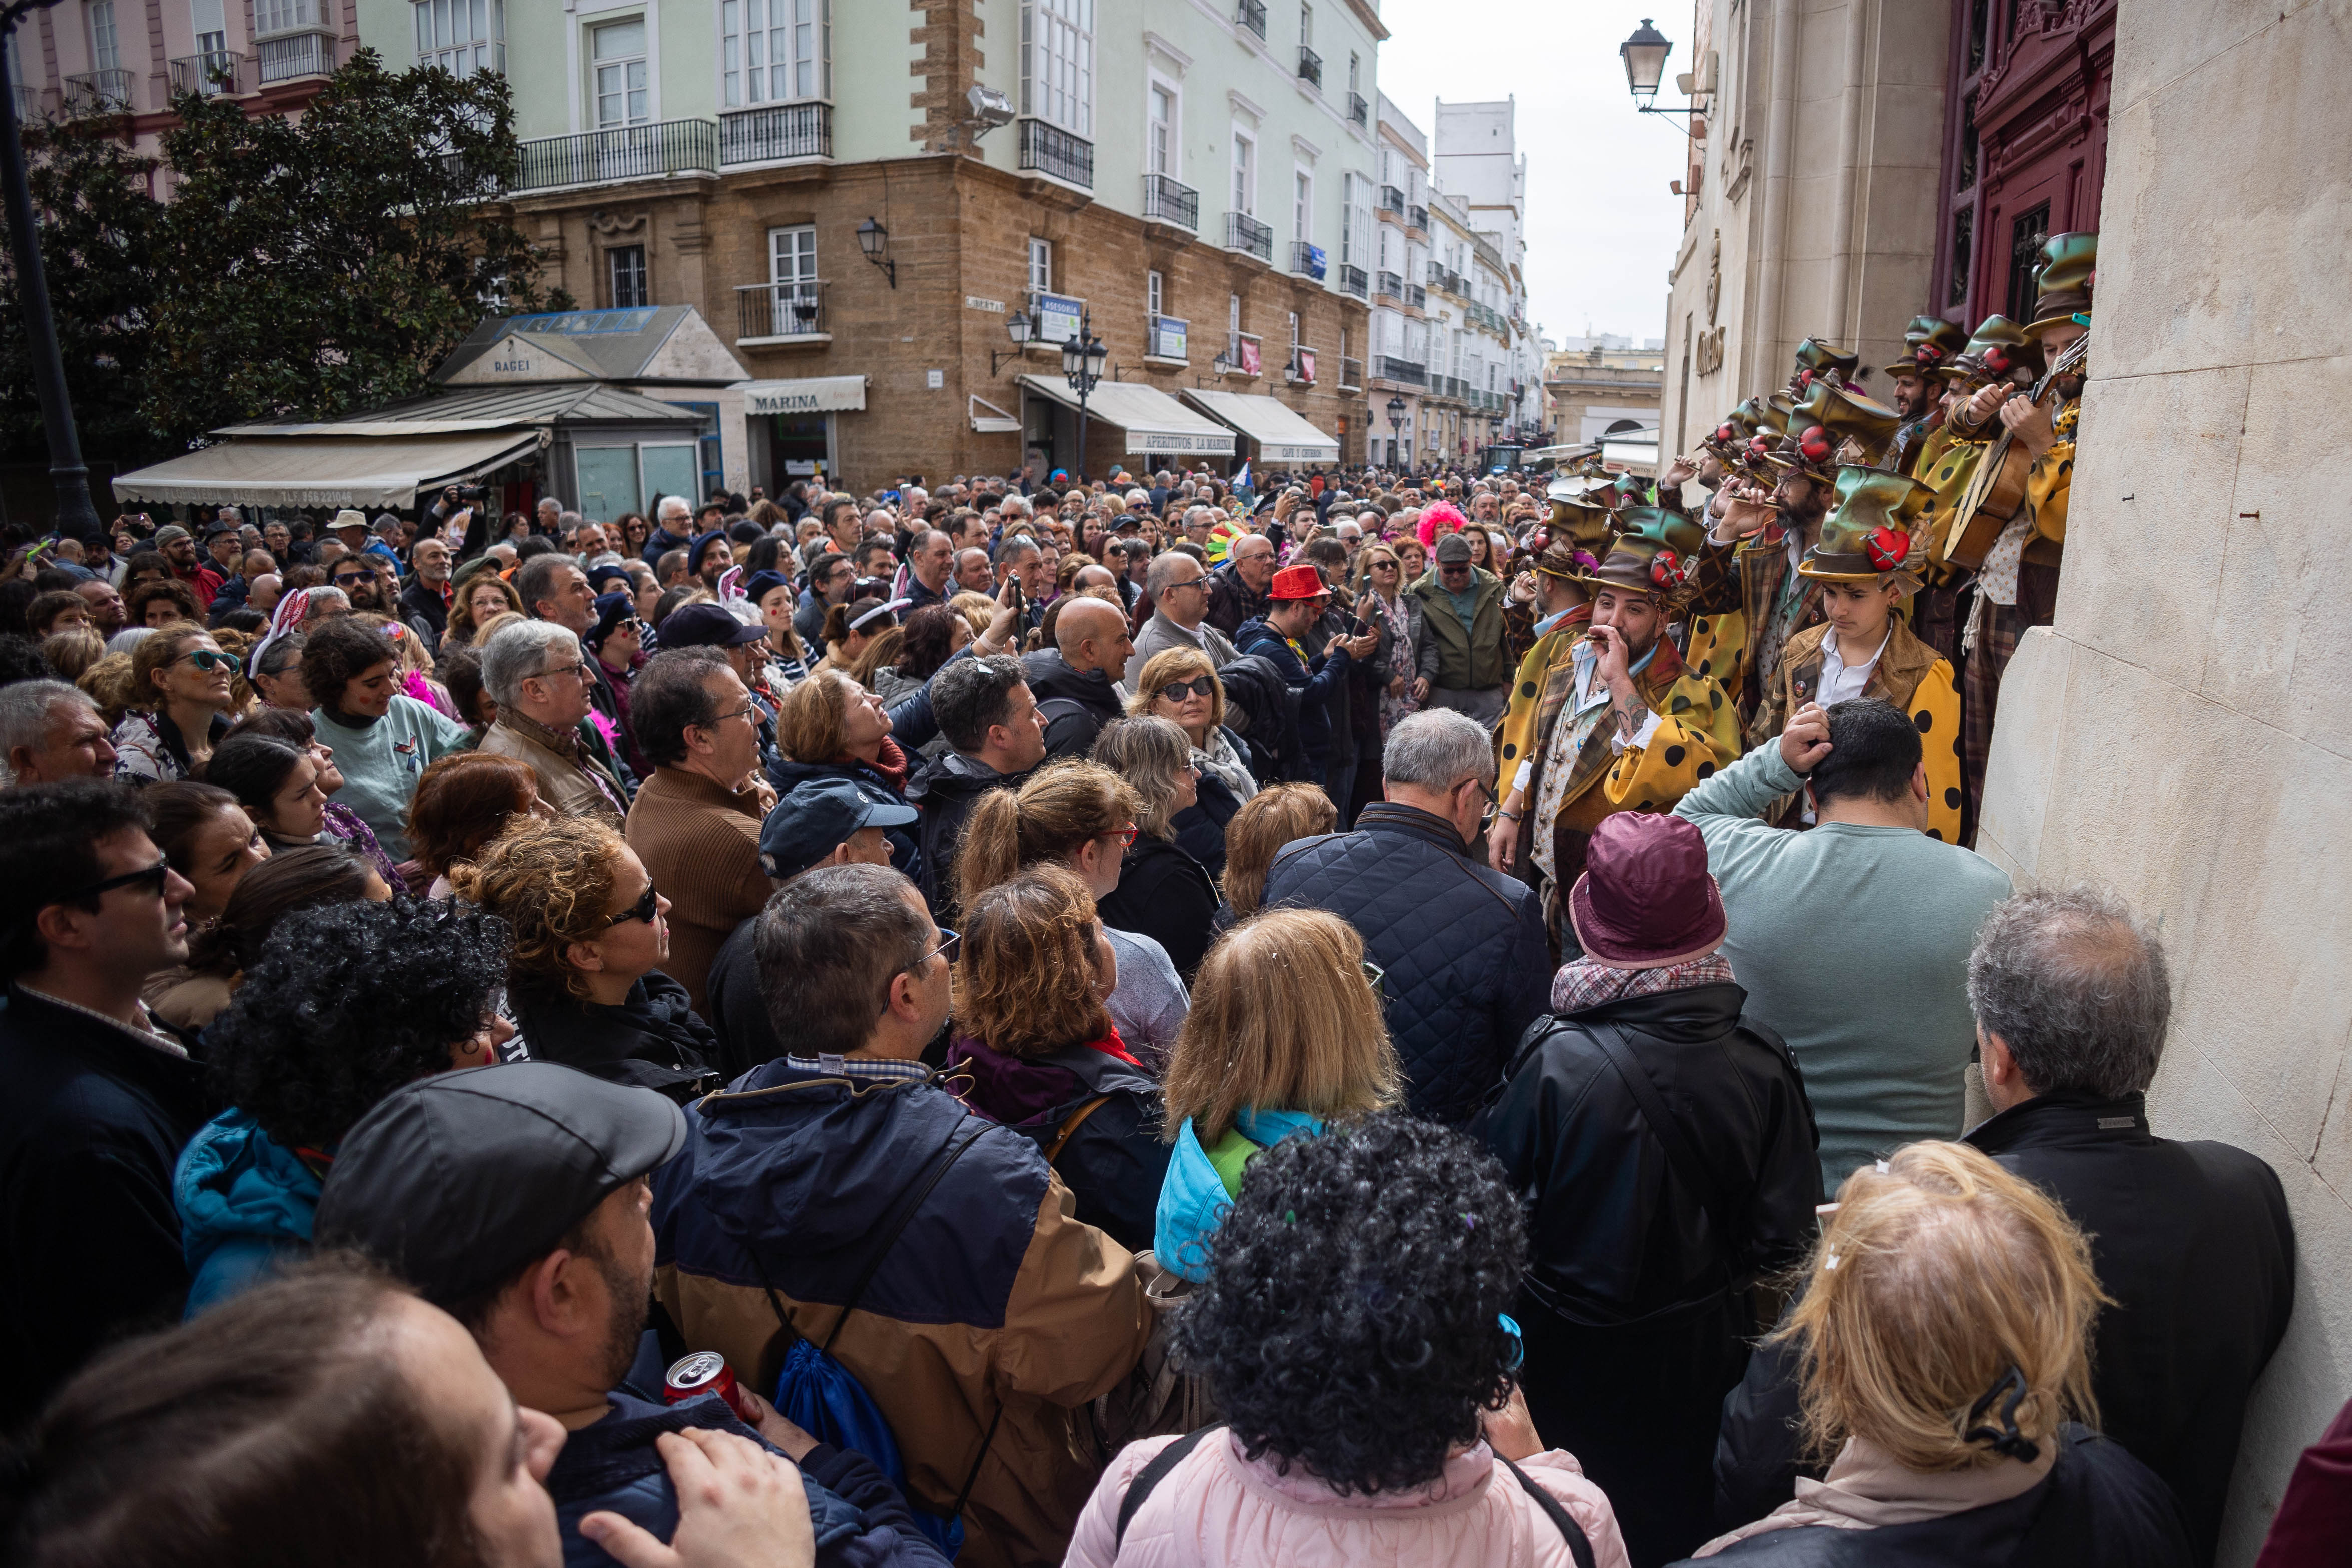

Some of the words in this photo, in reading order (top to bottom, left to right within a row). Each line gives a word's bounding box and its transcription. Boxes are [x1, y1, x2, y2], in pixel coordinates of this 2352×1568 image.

[755, 395, 819, 411] MARINA
[1146, 436, 1192, 449] APERITIVOS
[1196, 438, 1205, 449] LA
[1206, 439, 1231, 450] MARINA
